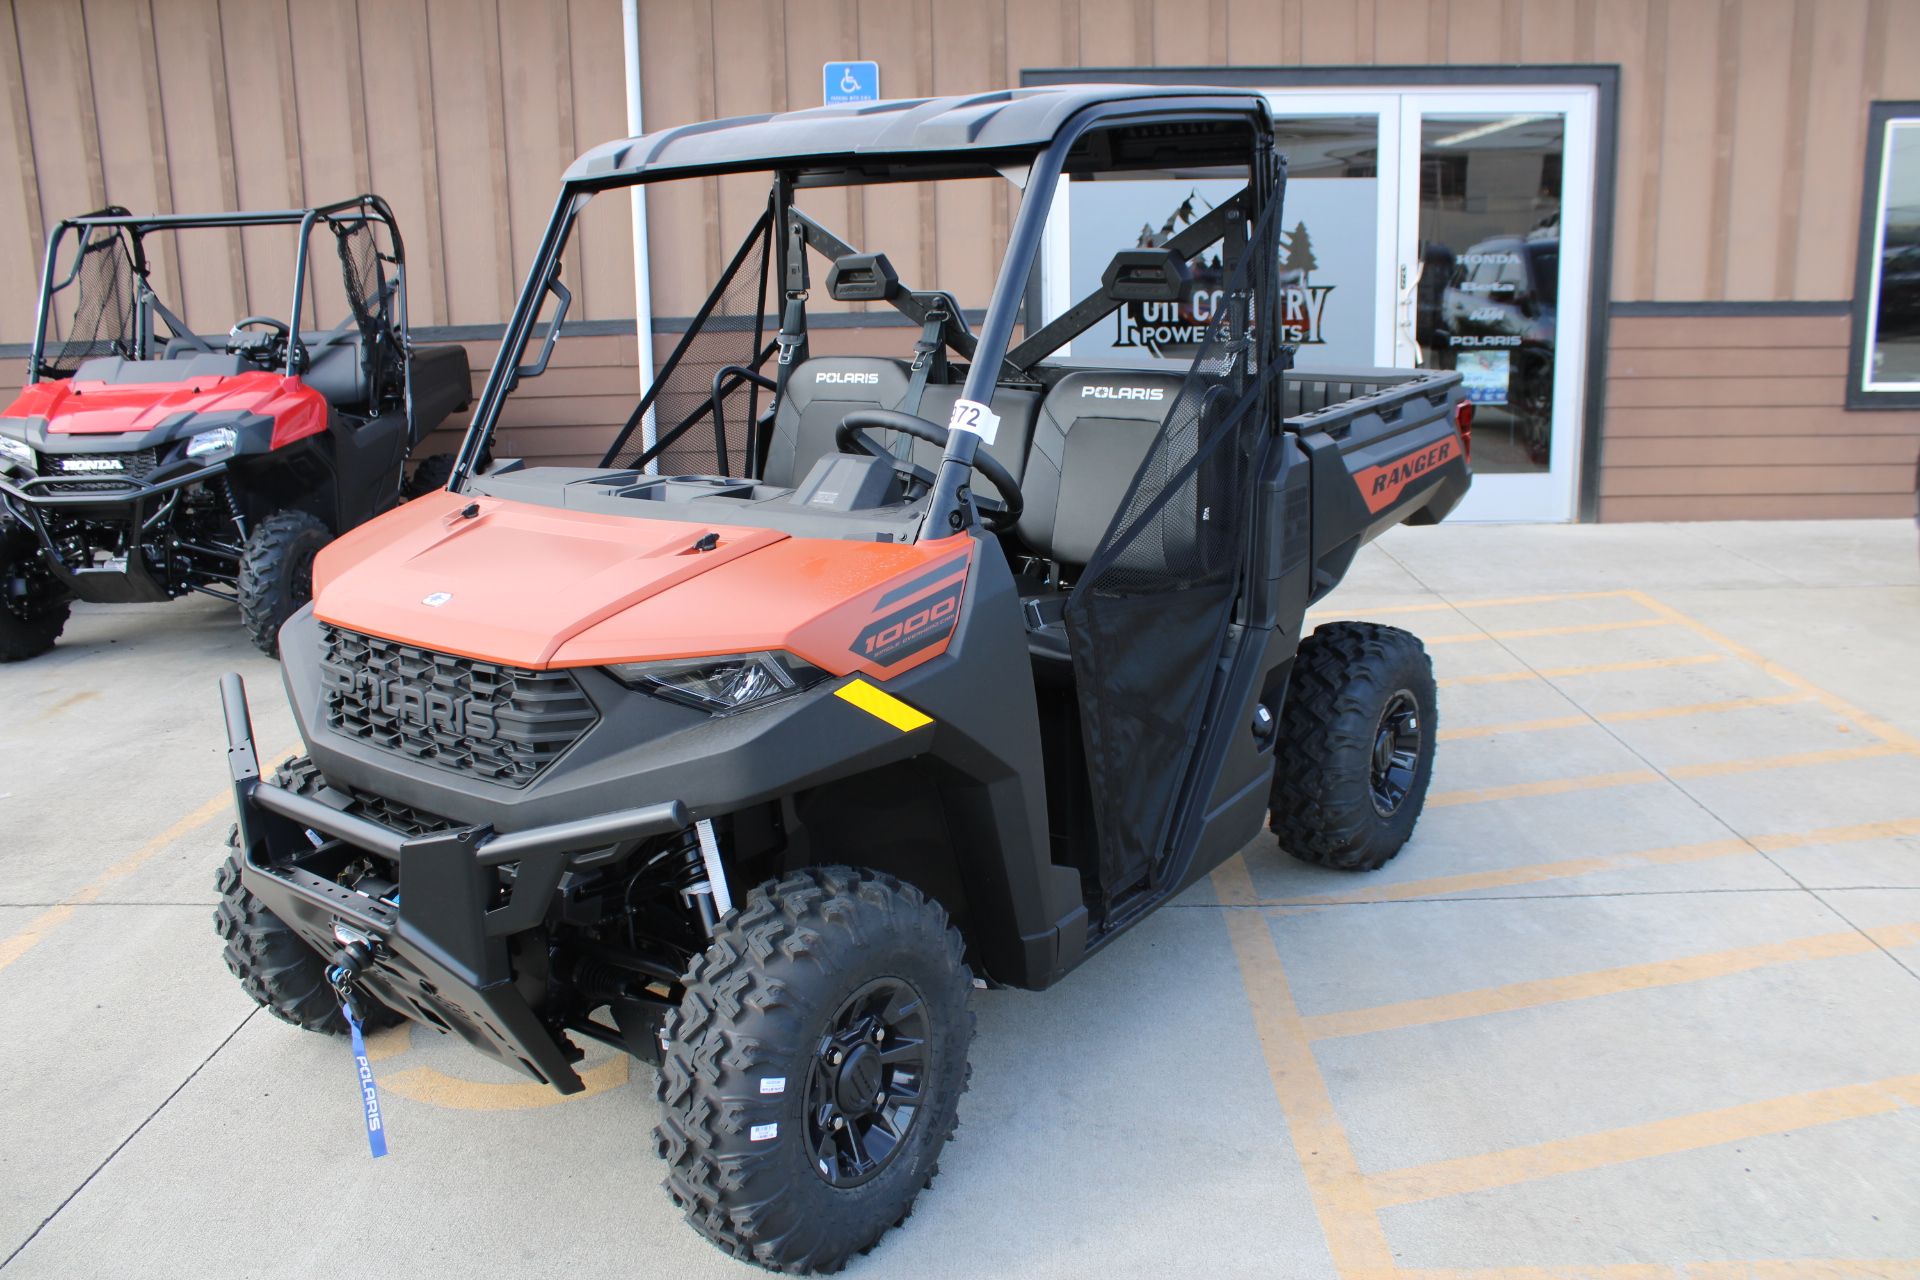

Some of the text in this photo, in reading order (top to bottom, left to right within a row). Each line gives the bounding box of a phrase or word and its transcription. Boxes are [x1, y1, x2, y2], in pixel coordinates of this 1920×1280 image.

[1456, 254, 1521, 264] HONDA
[1450, 335, 1522, 346] POLARIS
[815, 372, 879, 384] POLARIS
[1081, 385, 1164, 401] POLARIS
[63, 459, 124, 471] HONDA
[1372, 443, 1450, 496] RANGER
[865, 596, 955, 654] 1000
[334, 664, 498, 740] POLARIS
[356, 1055, 381, 1131] POLARIS
